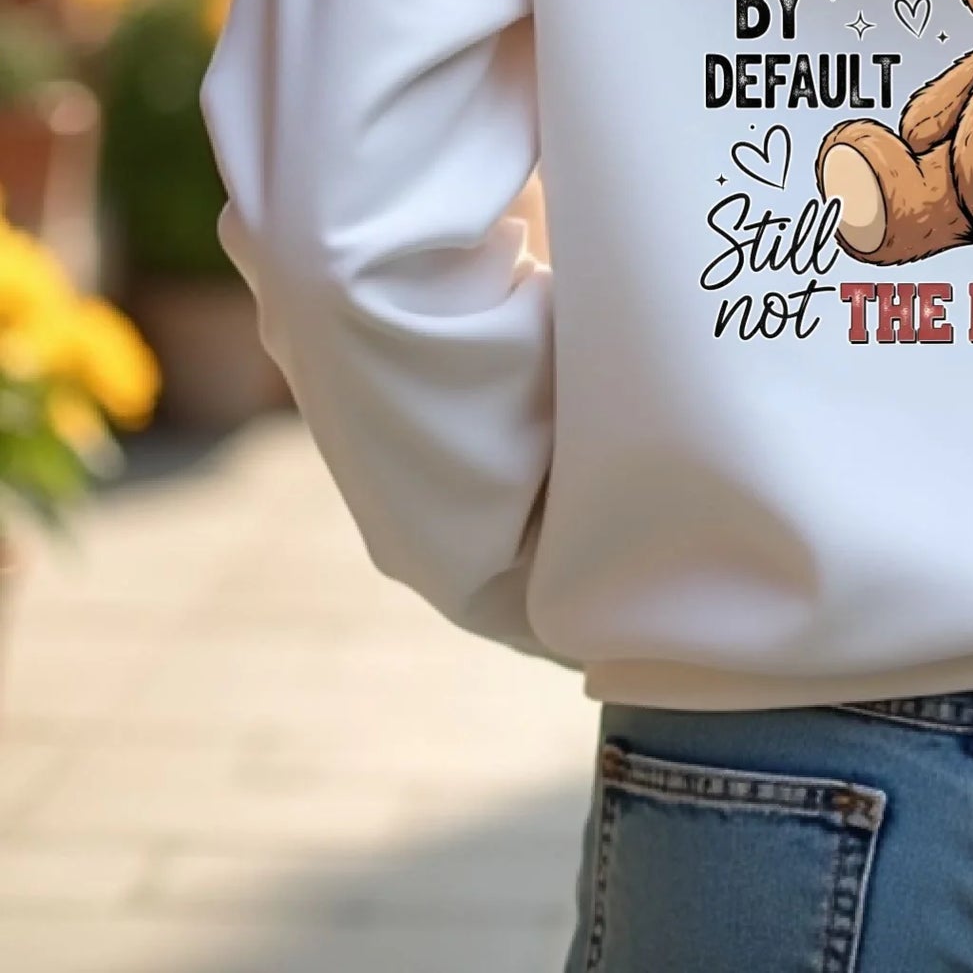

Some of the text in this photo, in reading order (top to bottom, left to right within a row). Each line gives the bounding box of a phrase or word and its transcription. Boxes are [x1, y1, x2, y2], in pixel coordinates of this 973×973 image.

[704, 53, 901, 110] DEFAULT
[699, 193, 844, 291] Still
[713, 279, 837, 342] not
[839, 282, 954, 344] THE
